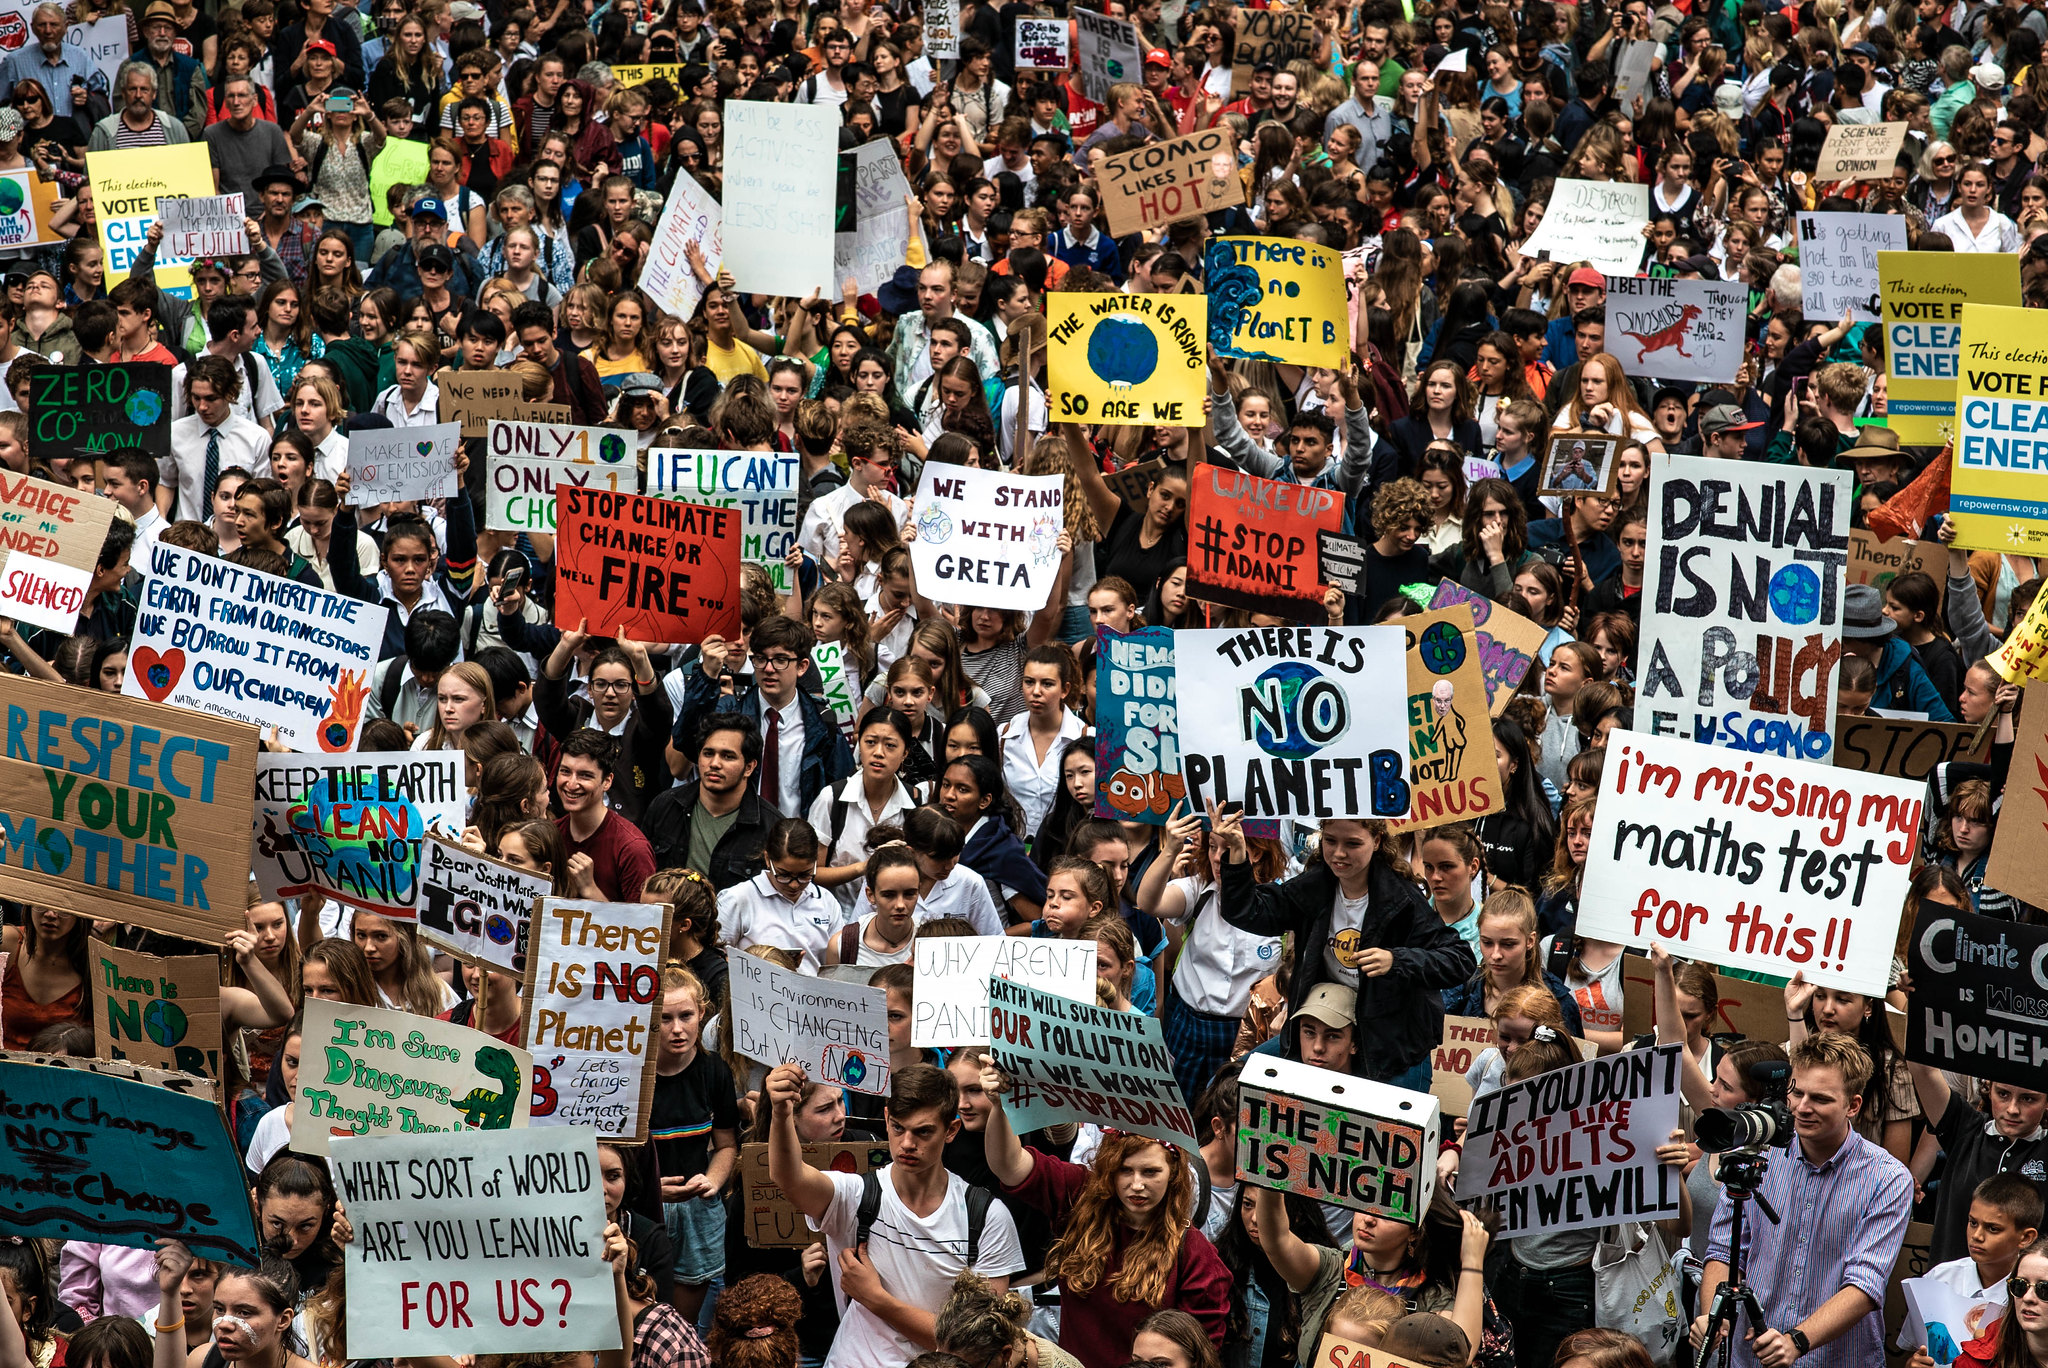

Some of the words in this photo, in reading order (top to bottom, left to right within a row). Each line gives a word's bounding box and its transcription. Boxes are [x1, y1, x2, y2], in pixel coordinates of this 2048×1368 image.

[1076, 11, 1136, 46] THERE
[1097, 37, 1111, 55] IS
[617, 68, 643, 80] THIS
[1841, 127, 1888, 139] SCIENCE
[1866, 137, 1894, 148] CARE
[1105, 133, 1222, 182] SCOMO
[1834, 147, 1861, 157] ABOUT
[1867, 147, 1887, 156] YOUR
[1836, 159, 1878, 172] OPINION
[98, 178, 122, 192] This
[126, 178, 167, 191] election,
[1122, 168, 1176, 196] LIKES
[1188, 159, 1211, 178] IT
[102, 198, 150, 215] VOTE
[158, 201, 174, 219] IF
[177, 199, 194, 218] YOU
[226, 195, 243, 214] ACT
[725, 201, 777, 230] LESS
[1139, 178, 1205, 223] HOT
[1, 234, 22, 244] HER
[181, 217, 203, 233] LIKE
[659, 190, 697, 267] CLIMATE
[172, 232, 199, 257] WE
[1232, 240, 1306, 266] There
[1804, 246, 1833, 268] hot
[1608, 276, 1617, 293] I
[1620, 276, 1647, 296] BET
[1649, 278, 1679, 297] THE
[1831, 270, 1864, 288] take
[1887, 280, 1914, 294] This
[1919, 283, 1967, 297] election,
[1615, 300, 1684, 335] DINOSAURS
[1707, 306, 1734, 321] THEY
[1805, 292, 1826, 312] all
[1889, 302, 1944, 319] VOTE
[1049, 313, 1084, 345] THE
[1090, 296, 1153, 315] WATER
[1156, 303, 1176, 324] IS
[1169, 318, 1203, 368] RISING
[1323, 322, 1336, 344] B
[1696, 321, 1715, 333] HAD
[1969, 342, 2000, 360] This
[32, 367, 130, 406] ZERO
[447, 381, 475, 400] We
[483, 387, 511, 399] NEED
[1968, 370, 2031, 394] VOTE
[1061, 392, 1088, 415] SO
[1102, 401, 1140, 418] ARE
[1153, 402, 1183, 420] WE
[85, 432, 143, 453] NOW
[365, 443, 404, 462] MAKE
[492, 421, 575, 457] ONLY
[388, 456, 455, 481] EMISSIONS
[657, 453, 692, 492] IF
[696, 454, 719, 496] U
[933, 478, 966, 501] WE
[994, 486, 1061, 508] STAND
[1213, 469, 1290, 511] WAKE
[1296, 490, 1333, 519] UP
[39, 521, 59, 534] ME
[566, 488, 628, 520] STOP
[632, 498, 728, 541] CLIMATE
[741, 498, 796, 528] THE
[961, 519, 1025, 542] WITH
[1237, 504, 1264, 520] AND
[1662, 479, 1849, 550] DENIAL
[579, 522, 668, 560] CHANGE
[674, 541, 702, 567] OR
[152, 546, 180, 578] WE
[186, 556, 243, 592] DON'T
[242, 573, 321, 614] INHERIT
[320, 596, 363, 624] THE
[560, 566, 595, 586] WE'LL
[599, 555, 690, 617] FIRE
[697, 596, 724, 612] YOU
[935, 554, 1031, 588] GRETA
[1226, 552, 1297, 591] ADANI
[1655, 545, 1717, 618] IS
[1, 570, 83, 614] SILENCED
[148, 579, 200, 617] EARTH
[209, 597, 258, 628] FROM
[288, 618, 370, 660] ANCESTORS
[140, 612, 167, 637] WE
[253, 640, 284, 665] IT
[286, 649, 339, 684] FROM
[1216, 627, 1312, 668] THERE
[1316, 628, 1365, 673] IS
[193, 661, 244, 700] OUR
[1642, 638, 1684, 697] A
[174, 694, 201, 709] NATIVE
[204, 702, 250, 722] AMERICAN
[1236, 676, 1351, 748] NO
[6, 704, 230, 803] RESPECT
[255, 767, 320, 802] KEEP
[320, 765, 374, 802] THE
[377, 761, 457, 803] EARTH
[1184, 753, 1362, 818] PLANET
[1369, 748, 1410, 817] B
[43, 767, 178, 850] YOUR
[286, 803, 408, 840] CLEAN
[1694, 761, 1851, 847] missing
[1858, 791, 1922, 865] my
[367, 838, 422, 863] NOT
[431, 843, 473, 873] Dear
[1613, 818, 1765, 885] maths
[1779, 829, 1882, 907] test
[447, 872, 498, 909] Learn
[552, 908, 661, 956] There
[1631, 888, 1709, 942] for
[917, 941, 980, 978] WHY
[1920, 918, 2019, 974] Climate
[100, 957, 154, 996] There
[592, 961, 661, 1005] NO
[737, 955, 762, 984] The
[770, 972, 869, 1013] Environment
[990, 978, 1028, 1008] EARTH
[1030, 991, 1067, 1021] WILL
[1070, 1003, 1146, 1036] SURVIVE
[535, 1008, 645, 1055] Planet
[741, 1018, 769, 1057] But
[770, 1002, 882, 1051] CHANGING
[991, 1007, 1035, 1050] OUR
[1040, 1020, 1171, 1075] POLLUTION
[402, 1030, 461, 1064] Sure
[1433, 1047, 1472, 1074] NO
[323, 1046, 452, 1105] Dinosaurs
[570, 1072, 630, 1095] change
[576, 1058, 620, 1074] Let's
[1040, 1059, 1091, 1089] WE
[559, 1101, 630, 1118] climate
[577, 1089, 608, 1104] for
[1466, 1084, 1524, 1140] IF
[1524, 1065, 1586, 1122] YOU
[1590, 1046, 1682, 1102] DON'T
[5, 1124, 95, 1155] NOT
[1244, 1096, 1321, 1145] THE
[1338, 1120, 1417, 1170] END
[1489, 1116, 1552, 1159] ACT
[1570, 1101, 1632, 1130] LIKE
[1488, 1123, 1636, 1188] ADULTS
[338, 1160, 401, 1203] WHAT
[408, 1157, 473, 1200] SORT
[508, 1151, 592, 1197] WORLD
[1246, 1136, 1290, 1181] IS
[1307, 1152, 1413, 1213] NIGH
[1584, 1164, 1679, 1219] WILL
[362, 1220, 411, 1263] ARE
[414, 1219, 469, 1261] YOU
[476, 1215, 590, 1259] LEAVING
[401, 1280, 473, 1330] FOR
